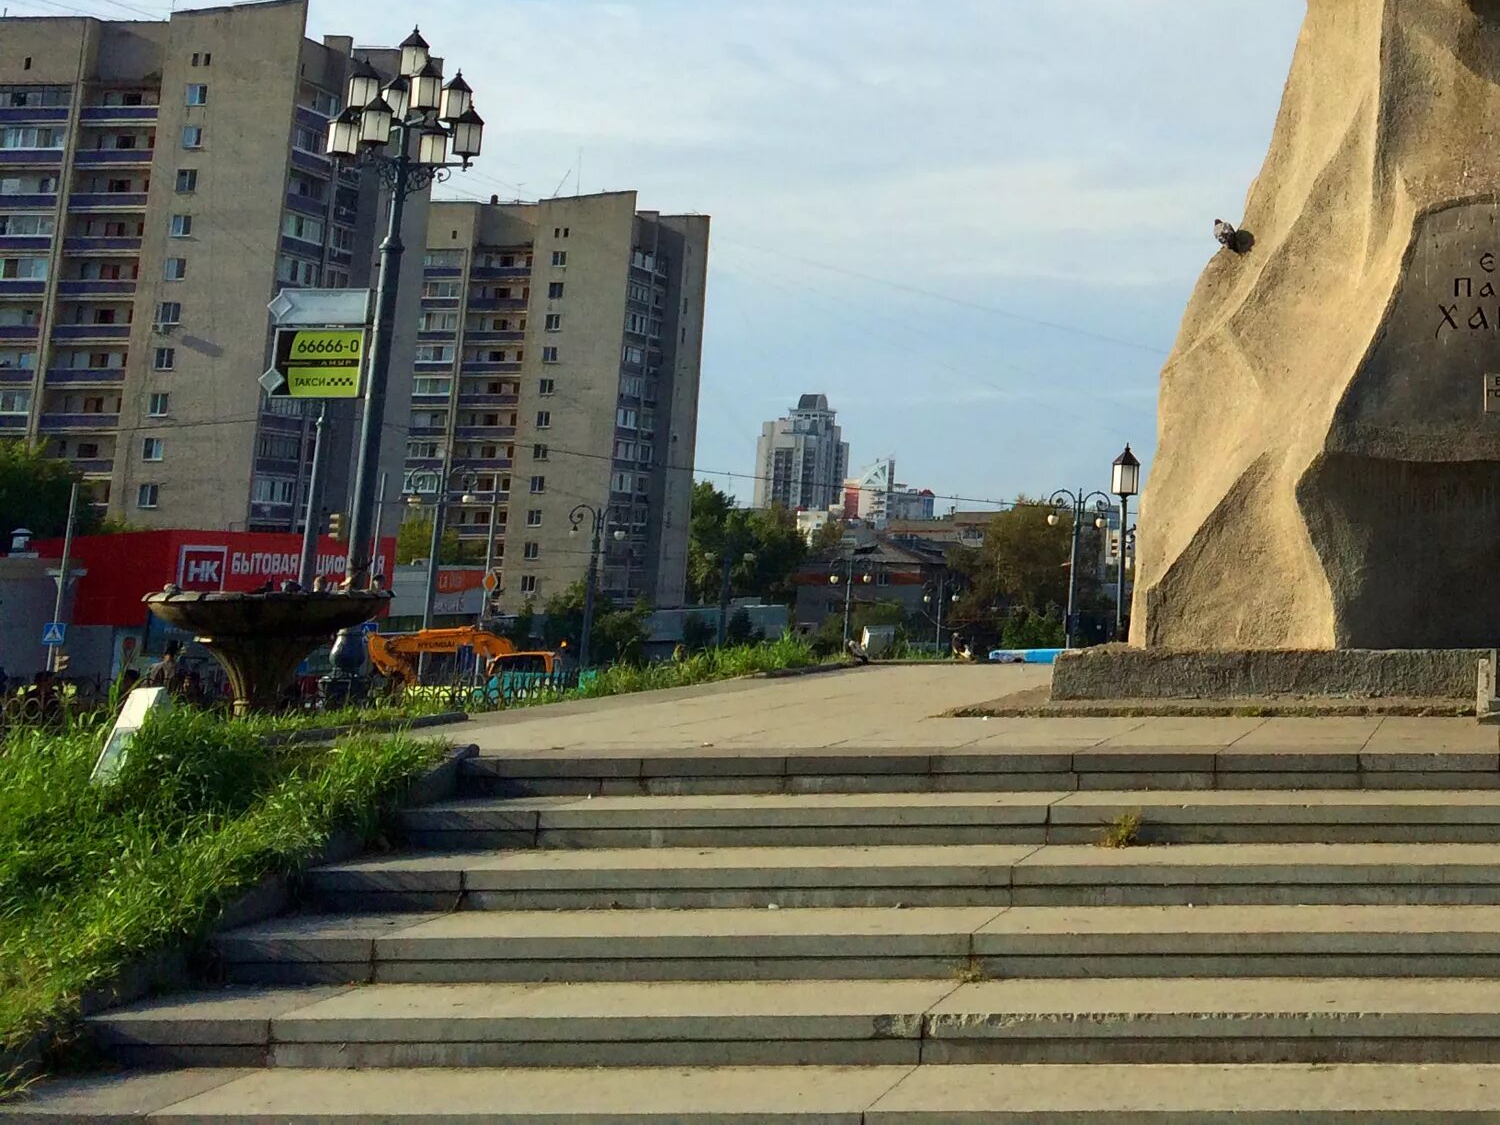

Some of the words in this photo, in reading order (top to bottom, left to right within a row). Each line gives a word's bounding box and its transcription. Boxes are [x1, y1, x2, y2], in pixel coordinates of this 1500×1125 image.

[297, 339, 359, 354] 66666-0
[294, 377, 326, 387] ТАКСИ
[187, 560, 220, 583] НК
[231, 552, 300, 575] БЫТОВАЯ
[315, 554, 385, 576] ЦИФЯ
